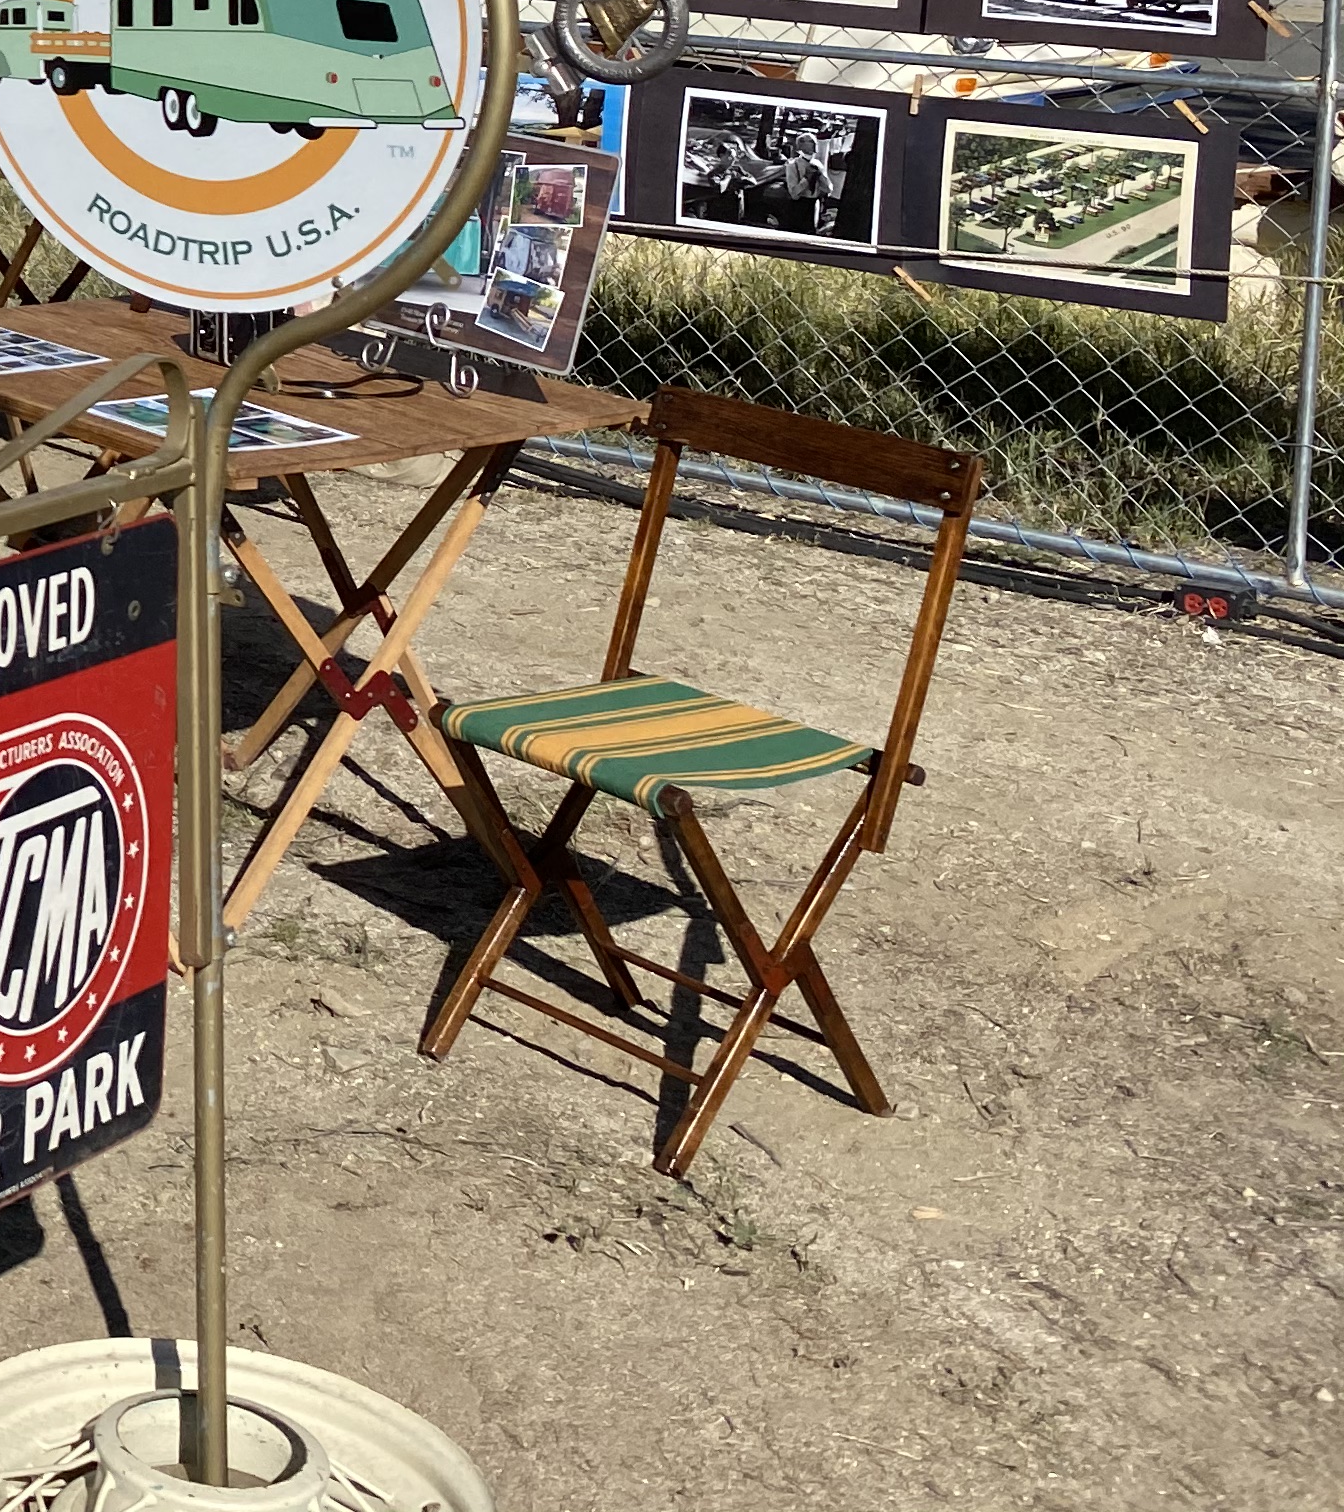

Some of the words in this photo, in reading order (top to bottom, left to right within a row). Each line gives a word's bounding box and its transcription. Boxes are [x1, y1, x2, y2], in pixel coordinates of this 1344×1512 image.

[386, 145, 415, 159] TM
[87, 193, 253, 265] ROADTRIP
[265, 203, 360, 258] U.S.A.
[57, 730, 126, 788] ASSOCIATION
[23, 1031, 146, 1165] PARK
